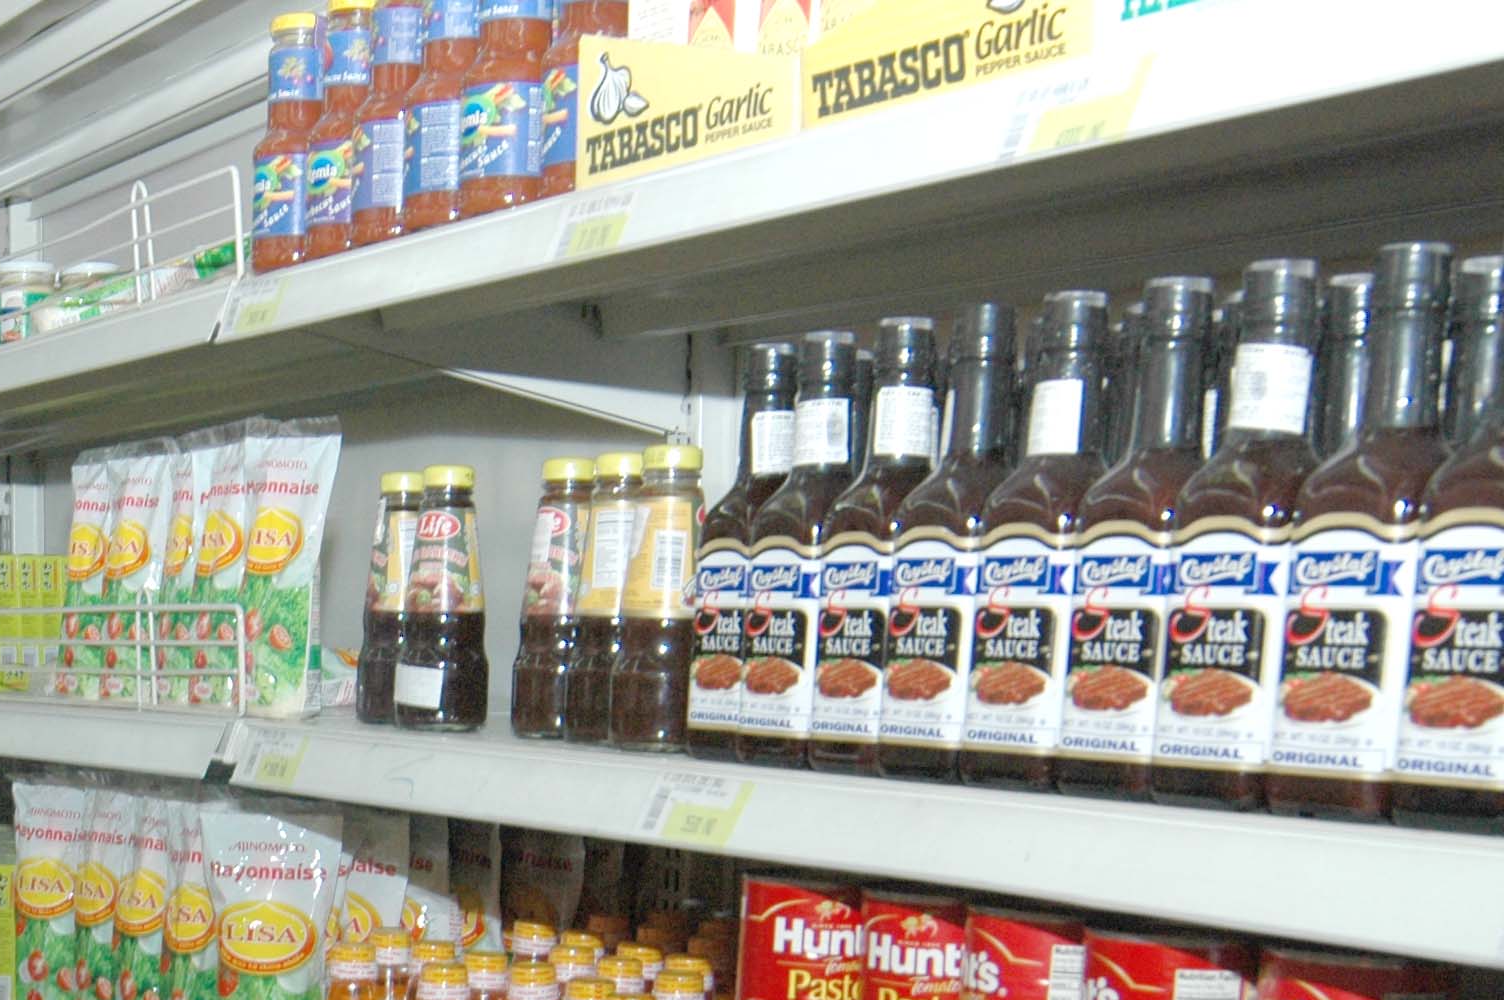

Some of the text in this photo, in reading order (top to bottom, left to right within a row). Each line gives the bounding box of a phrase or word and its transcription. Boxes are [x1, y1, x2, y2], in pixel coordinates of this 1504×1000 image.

[975, 4, 1066, 60] Garlic
[975, 42, 1066, 77] PEPPER SAUCE
[812, 33, 967, 119] TABASCO
[705, 82, 773, 130] Garlic
[586, 107, 698, 175] TABASCO
[705, 118, 773, 144] PEPPER SAUCE
[419, 515, 454, 537] Life
[700, 565, 745, 590] Crystal
[751, 564, 797, 590] Crystal
[824, 561, 874, 588] Crystal
[896, 559, 951, 588] Crystal
[984, 557, 1045, 587] Crystal
[1081, 556, 1147, 587] Crystal
[1180, 554, 1253, 586] Crystal
[1297, 551, 1376, 585] Crystal
[695, 588, 742, 635] Steak
[745, 589, 795, 636] Steak
[819, 588, 873, 637] Steak
[888, 587, 954, 637] Steak
[975, 585, 1041, 638] Steak
[1071, 585, 1143, 641] Steak
[1168, 585, 1248, 643] Steak
[1285, 583, 1370, 645] Steak
[701, 636, 739, 652] SAUCE
[752, 637, 793, 653] SAUCE
[825, 637, 871, 654] SAUCE
[896, 638, 945, 655] SAUCE
[984, 639, 1039, 658] SAUCE
[1081, 641, 1141, 660] SAUCE
[1181, 643, 1246, 664] SAUCE
[1296, 646, 1366, 668] SAUCE
[1422, 647, 1500, 671] SAUCE
[738, 715, 793, 729] ORIGINAL
[812, 720, 871, 734] ORIGINAL
[880, 724, 944, 738] ORIGINAL
[967, 729, 1038, 744] ORIGINAL
[1063, 736, 1141, 752] ORIGINAL
[1160, 743, 1243, 760] ORIGINAL
[1272, 750, 1363, 770] ORIGINAL
[1397, 757, 1495, 777] ORIGINAL
[226, 923, 297, 945] LISA
